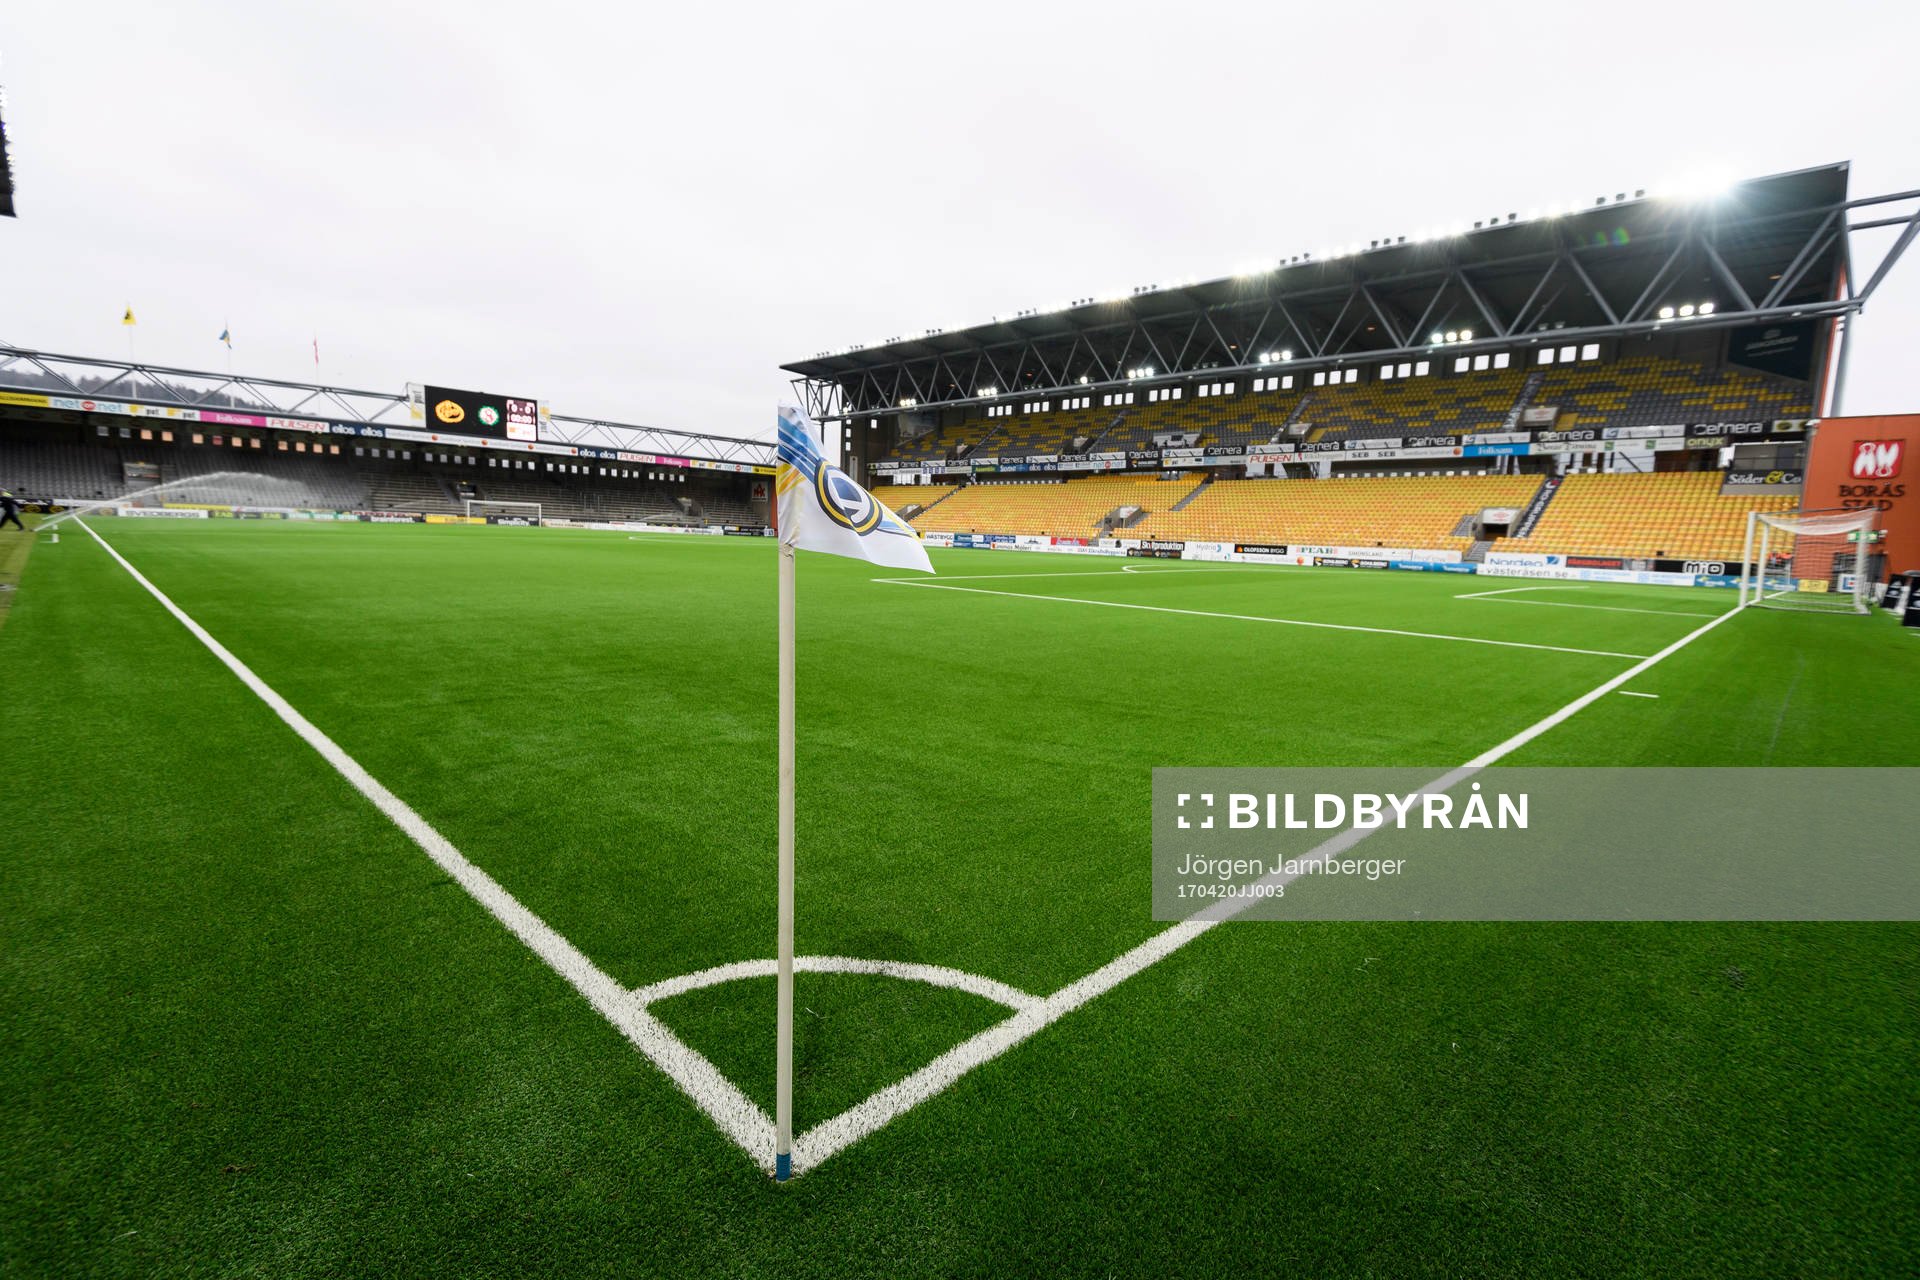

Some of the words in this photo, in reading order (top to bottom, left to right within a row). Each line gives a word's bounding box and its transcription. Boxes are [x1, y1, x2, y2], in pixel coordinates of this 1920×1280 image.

[270, 418, 325, 431] PULSEN
[1687, 437, 1724, 447] onyx
[1478, 447, 1514, 455] Folksam
[1250, 454, 1292, 463] PULSEN
[1838, 482, 1905, 497] BORÅS
